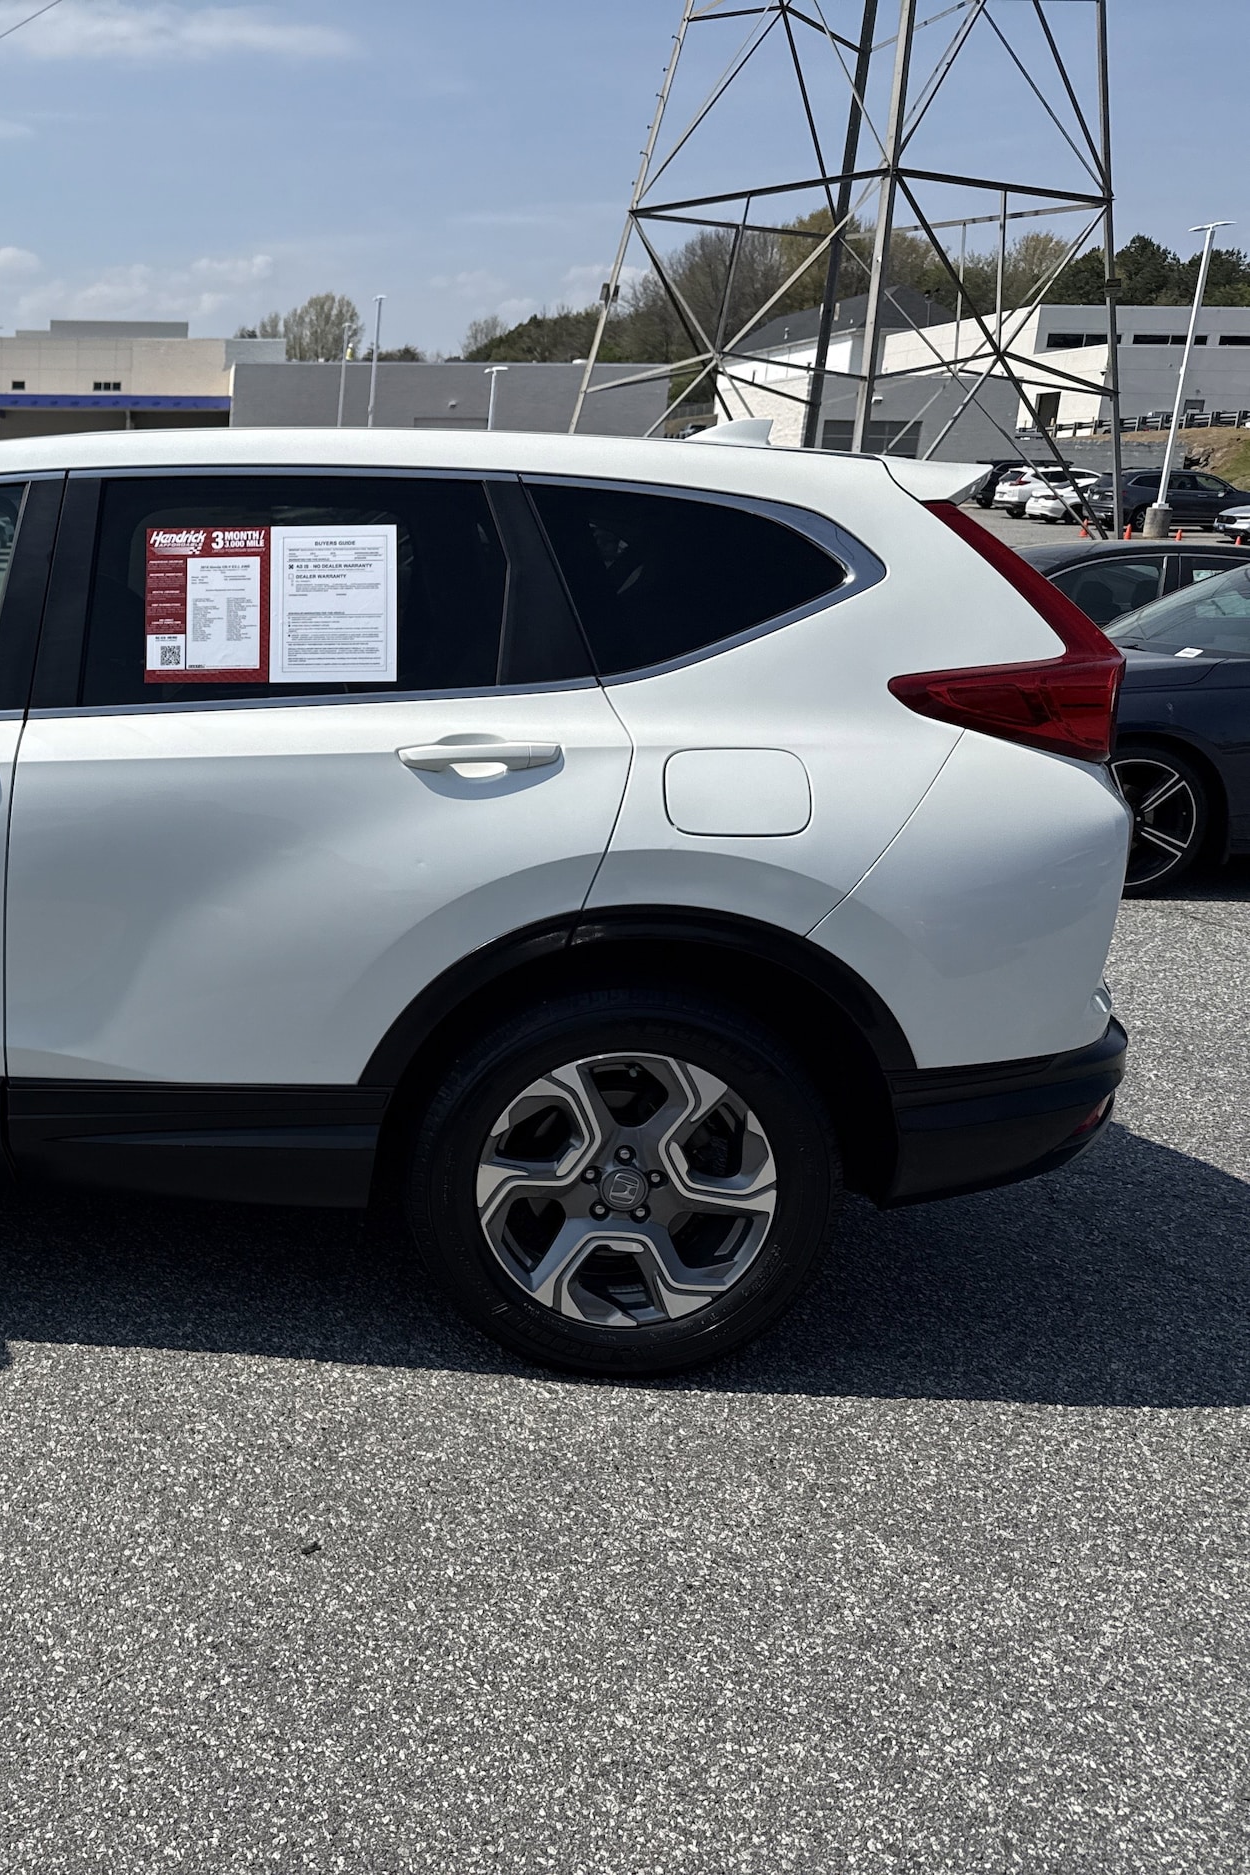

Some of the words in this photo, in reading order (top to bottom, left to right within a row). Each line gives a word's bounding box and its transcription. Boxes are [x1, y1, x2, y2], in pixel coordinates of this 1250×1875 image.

[149, 530, 207, 547] Hendrick
[211, 531, 224, 549] 3
[224, 530, 265, 541] MONTH/
[246, 539, 265, 547] MILE
